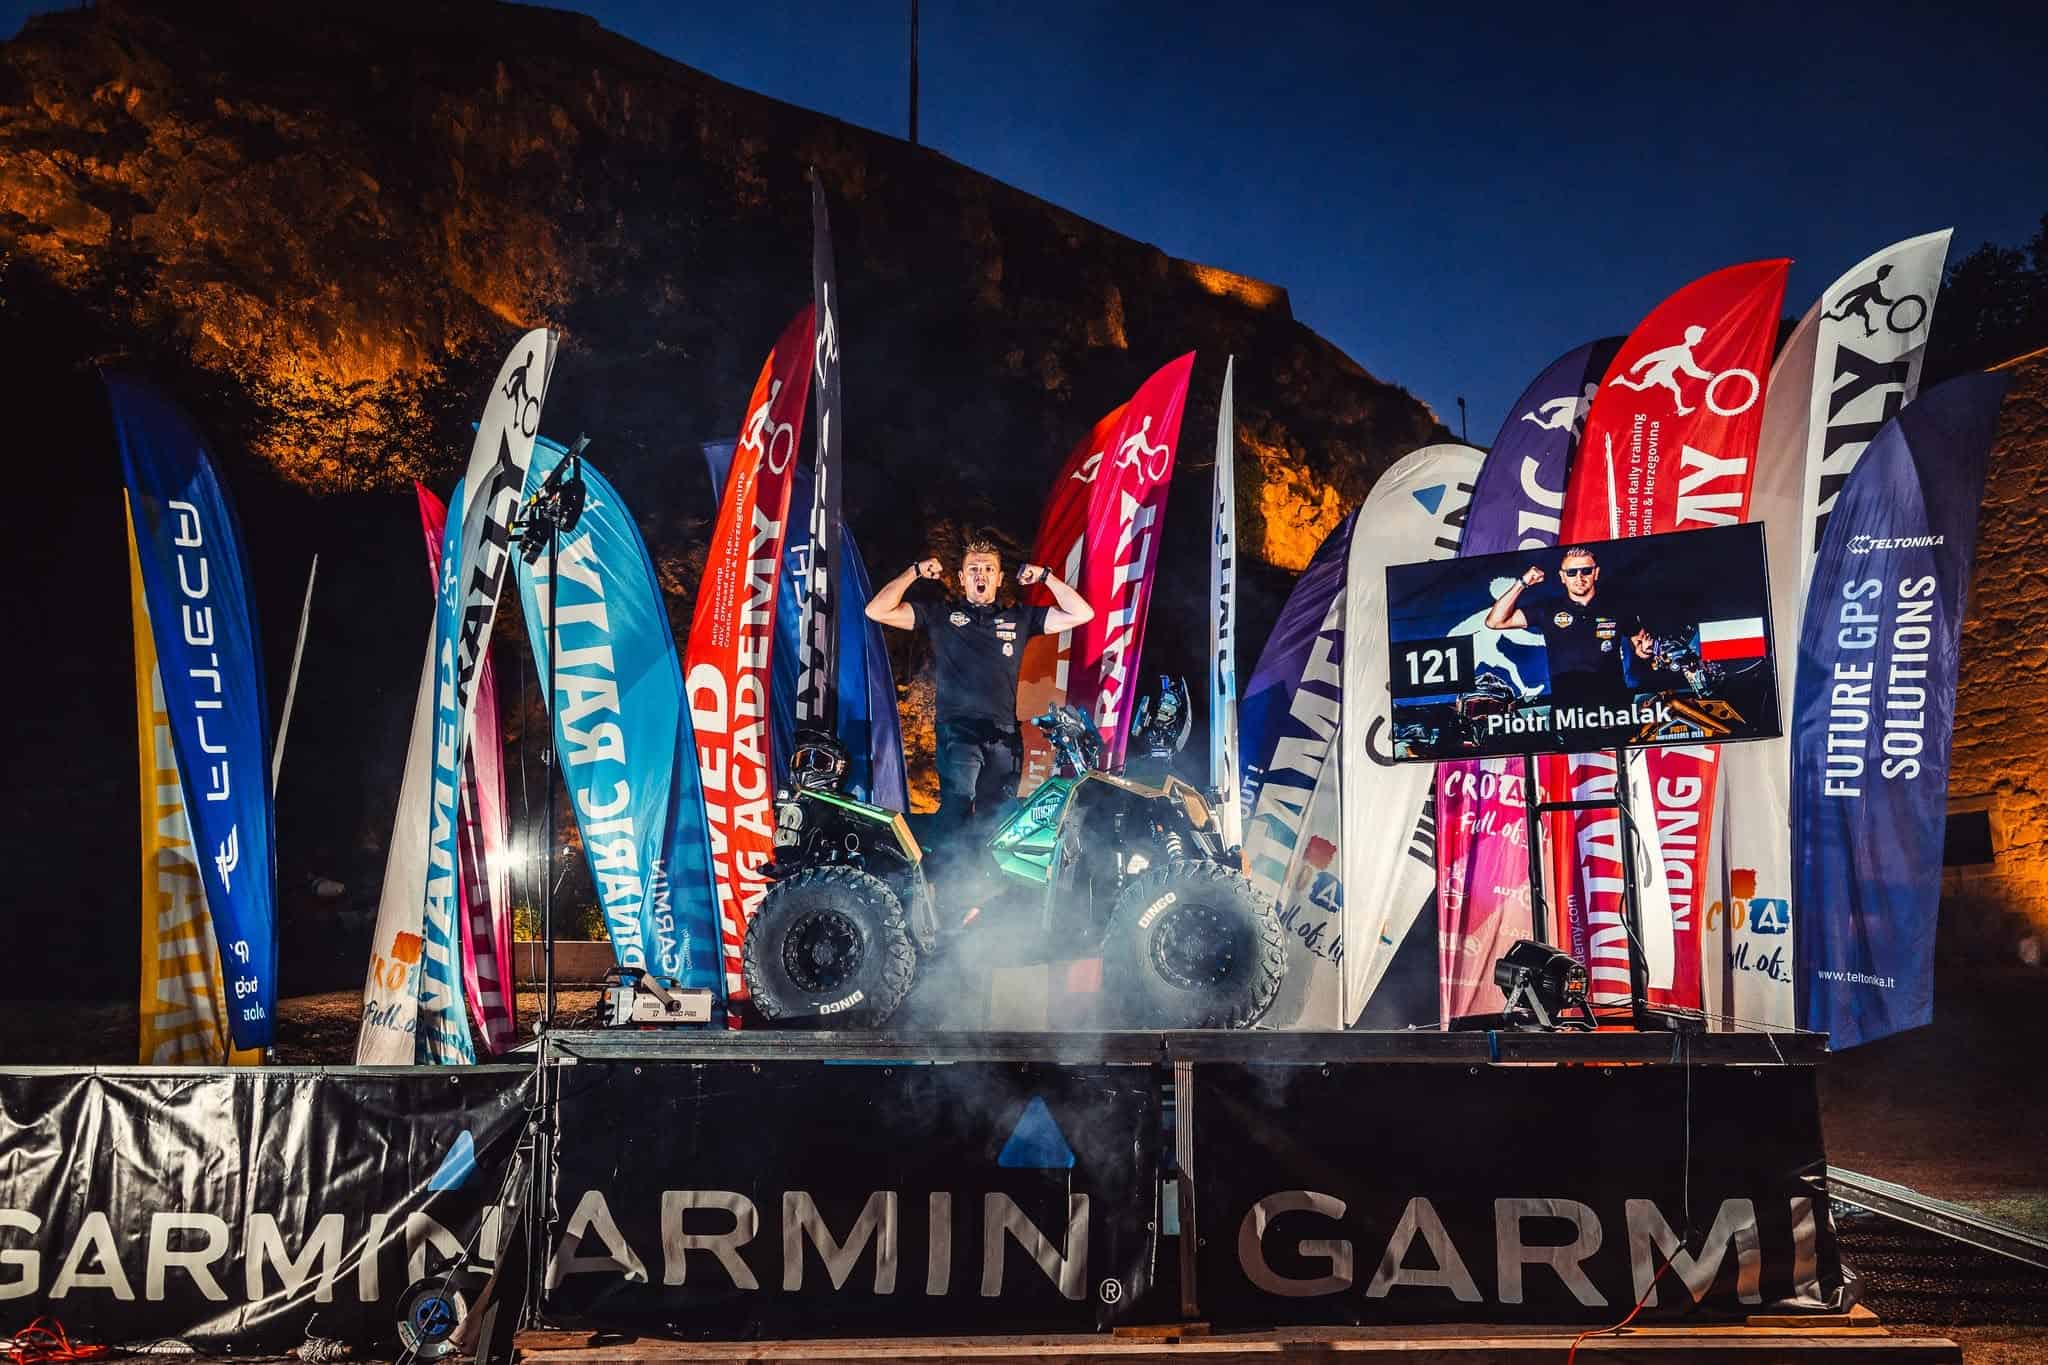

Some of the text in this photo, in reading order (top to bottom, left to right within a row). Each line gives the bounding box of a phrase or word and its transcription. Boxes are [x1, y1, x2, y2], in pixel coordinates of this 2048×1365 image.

[1630, 413, 1647, 464] training
[1628, 466, 1643, 495] Rally
[1641, 420, 1661, 536] osnia & Herzegovina
[1627, 497, 1639, 516] and
[1868, 535, 1944, 551] TELTONIKA
[1095, 489, 1157, 728] RALLY
[731, 504, 781, 837] ACADEMY
[1406, 648, 1459, 686] 121
[1825, 578, 1883, 798] FUTURE GPS
[1881, 575, 1937, 781] SOLUTIONS
[1487, 702, 1671, 735] Piotr Michalak
[1137, 891, 1177, 930] DINGO
[819, 989, 865, 1016] DINGO
[544, 1190, 1091, 1300] ARMIN
[1238, 1190, 1824, 1307] GARMI
